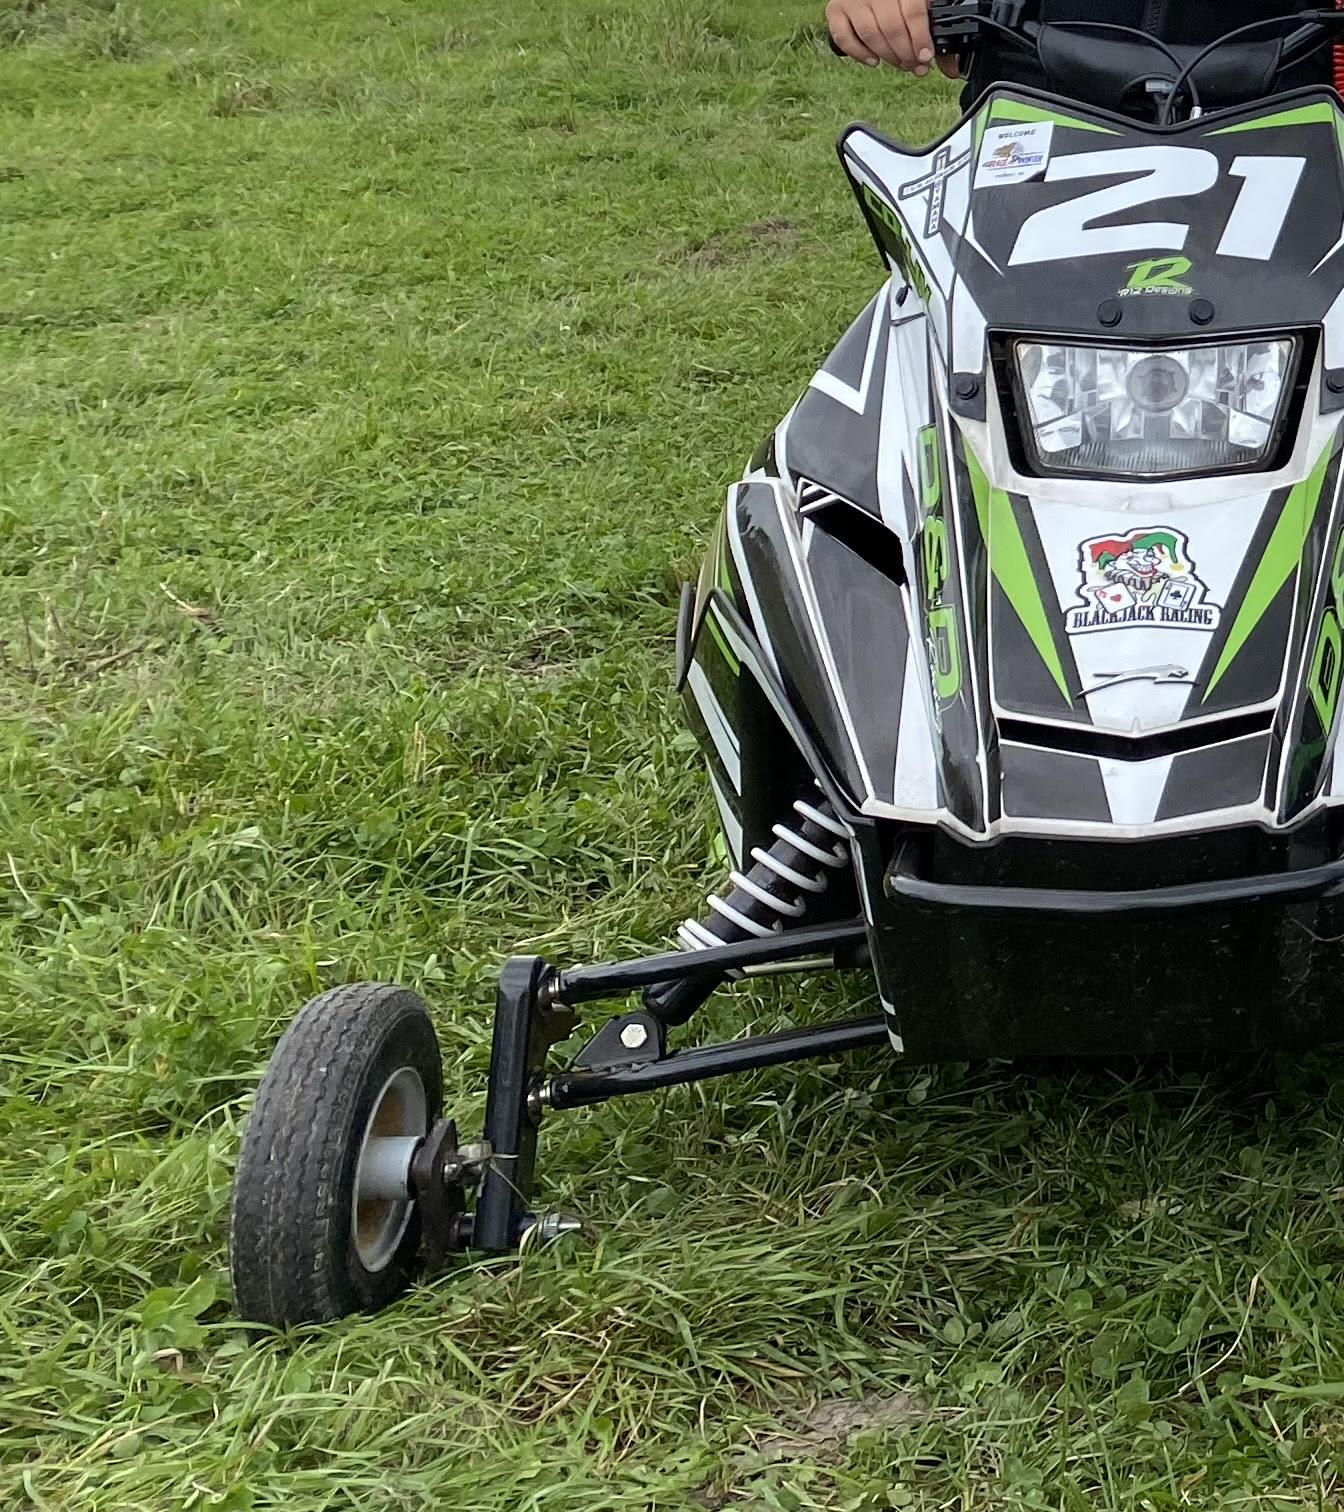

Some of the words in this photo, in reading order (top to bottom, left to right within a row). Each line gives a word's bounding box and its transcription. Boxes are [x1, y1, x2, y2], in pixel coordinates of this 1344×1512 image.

[998, 129, 1037, 139] WELCOME
[1008, 145, 1306, 266] 21
[1160, 605, 1214, 625] RACING
